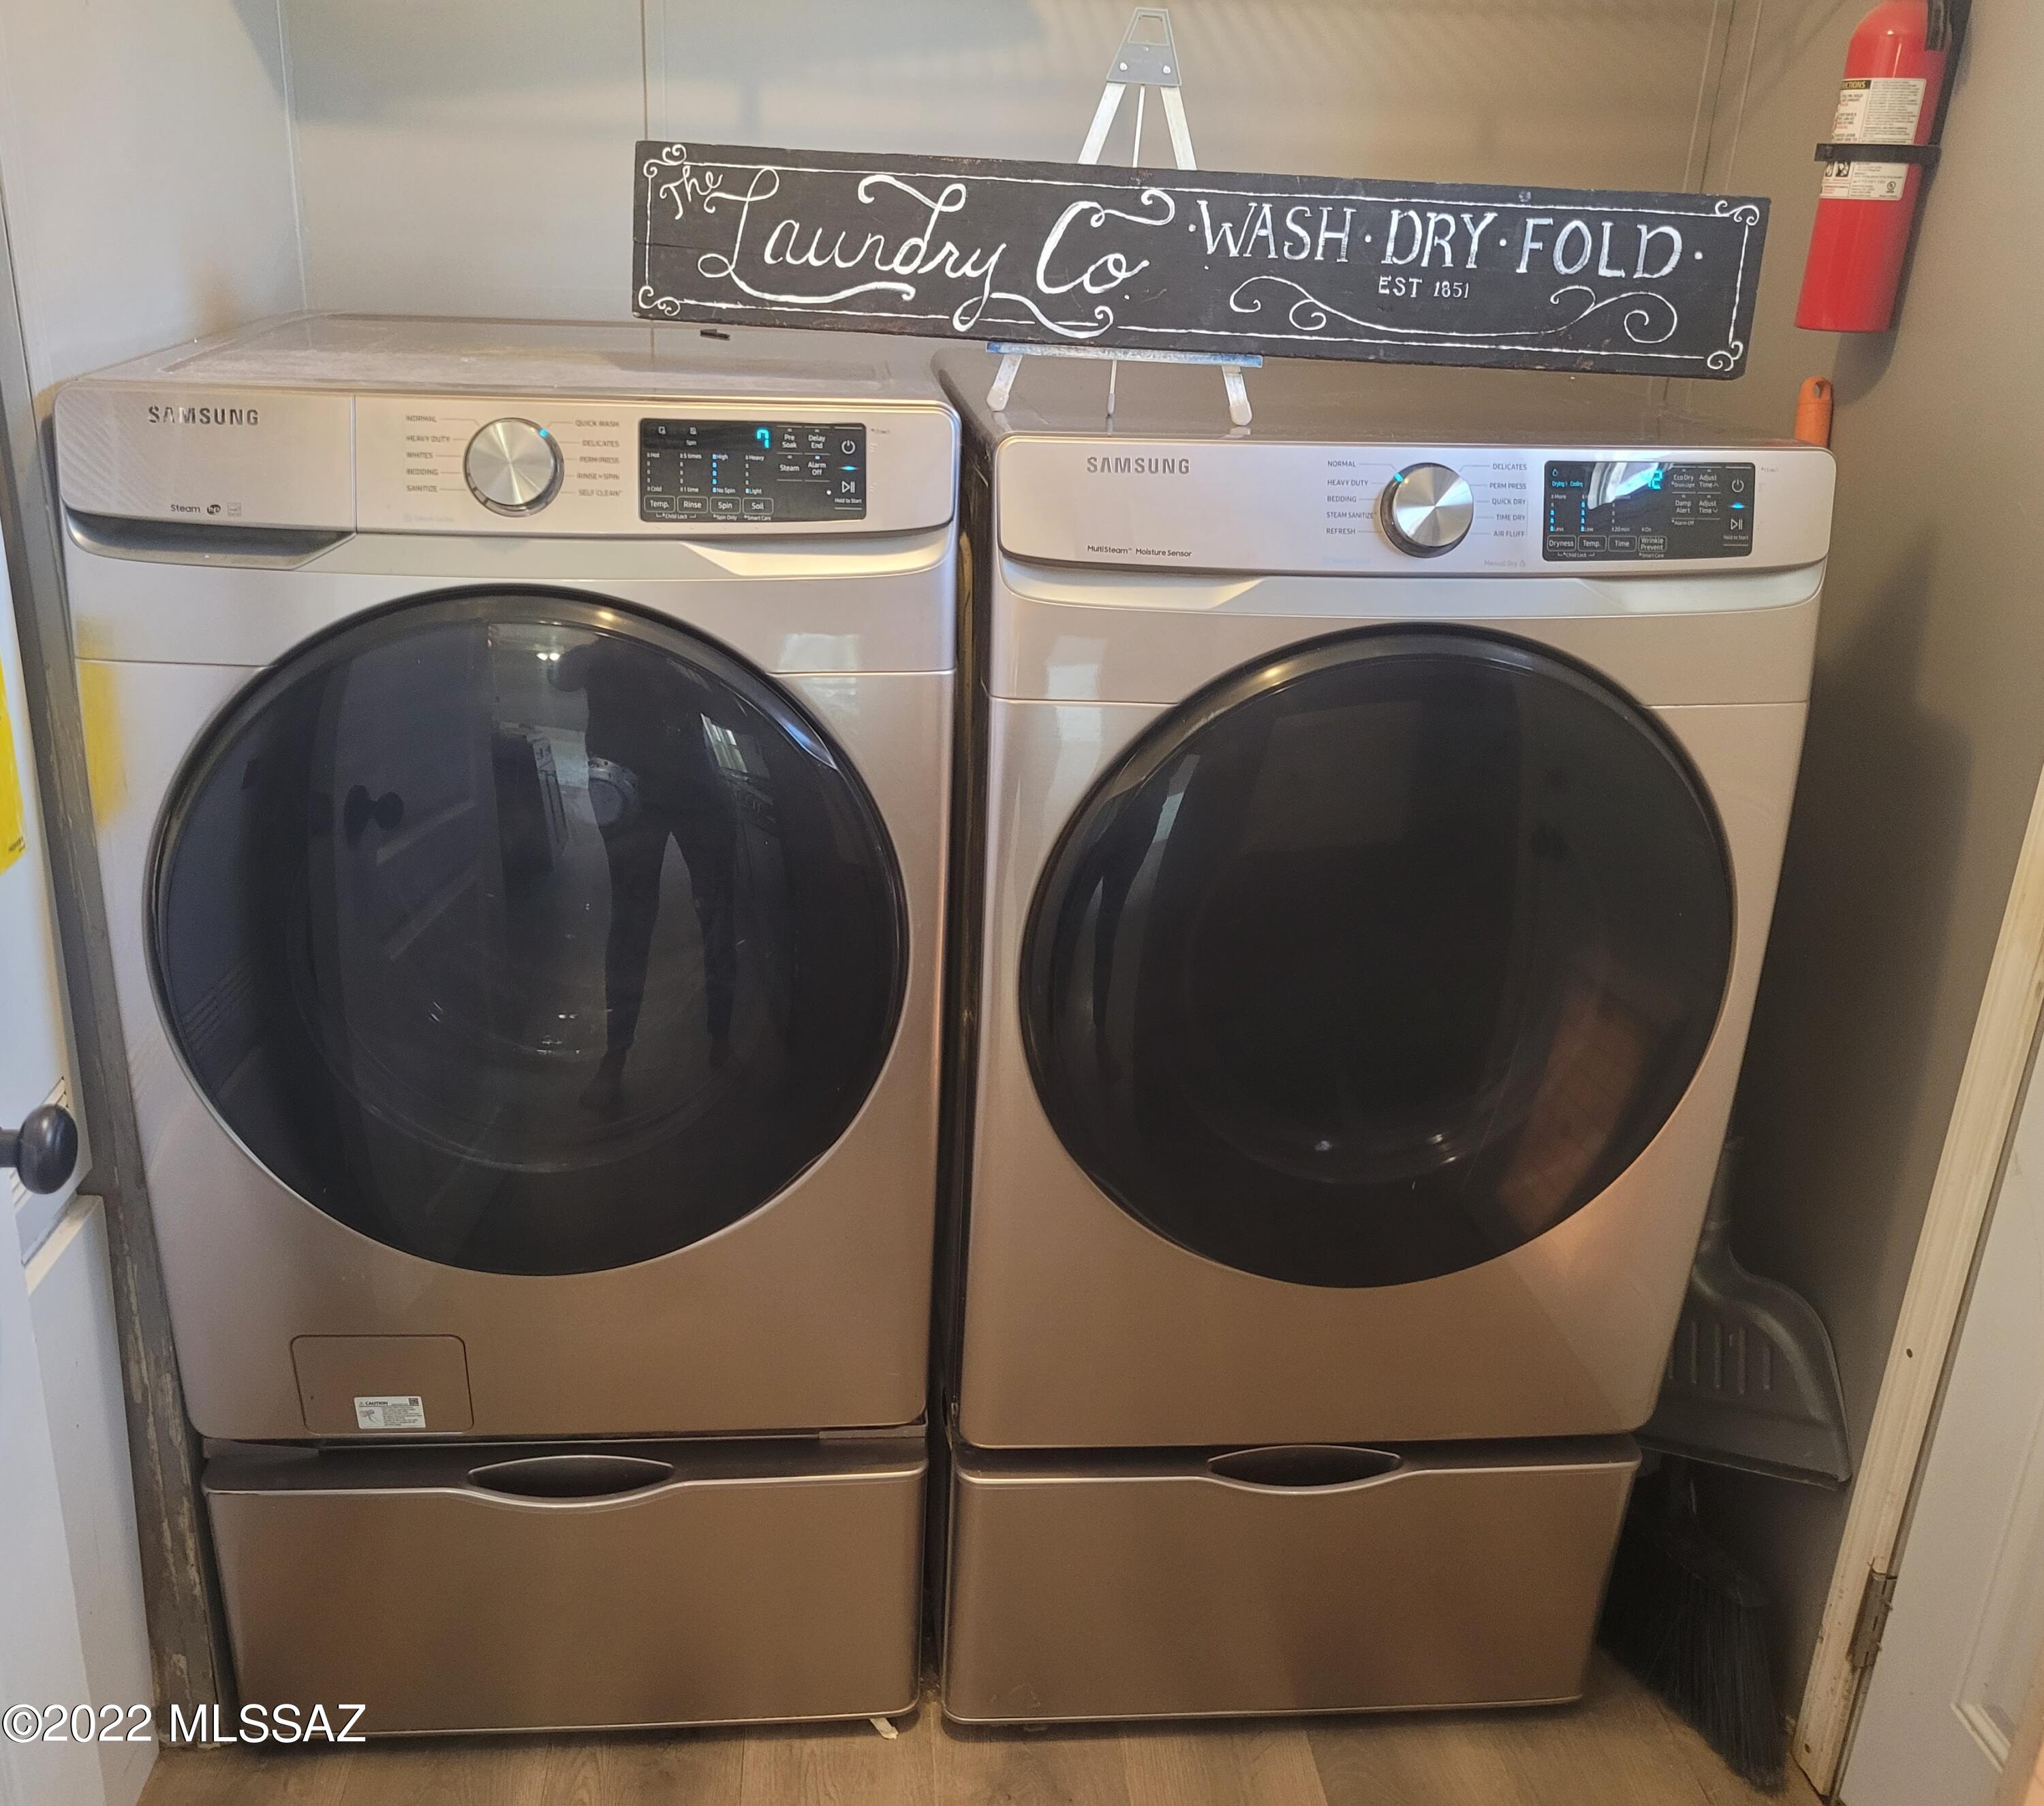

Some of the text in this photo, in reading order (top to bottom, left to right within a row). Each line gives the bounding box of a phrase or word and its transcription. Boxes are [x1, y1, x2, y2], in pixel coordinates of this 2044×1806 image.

[1196, 200, 1683, 279] WASH DRY FOLD
[660, 164, 723, 219] The
[698, 168, 1006, 331] Laundry
[1378, 275, 1470, 299] EST 1851
[149, 406, 259, 426] SAMSUNG
[582, 439, 620, 448] DELICATES
[808, 435, 826, 443] Delay
[1087, 456, 1190, 474] SAMSUNG
[650, 500, 670, 508] Temp.
[718, 501, 732, 510] Spin
[170, 505, 200, 513] Steam
[1549, 540, 1574, 548] Dryness
[1136, 548, 1166, 556] Moisture
[1167, 549, 1192, 557] Sensor
[1484, 559, 1518, 569] Manual Dry
